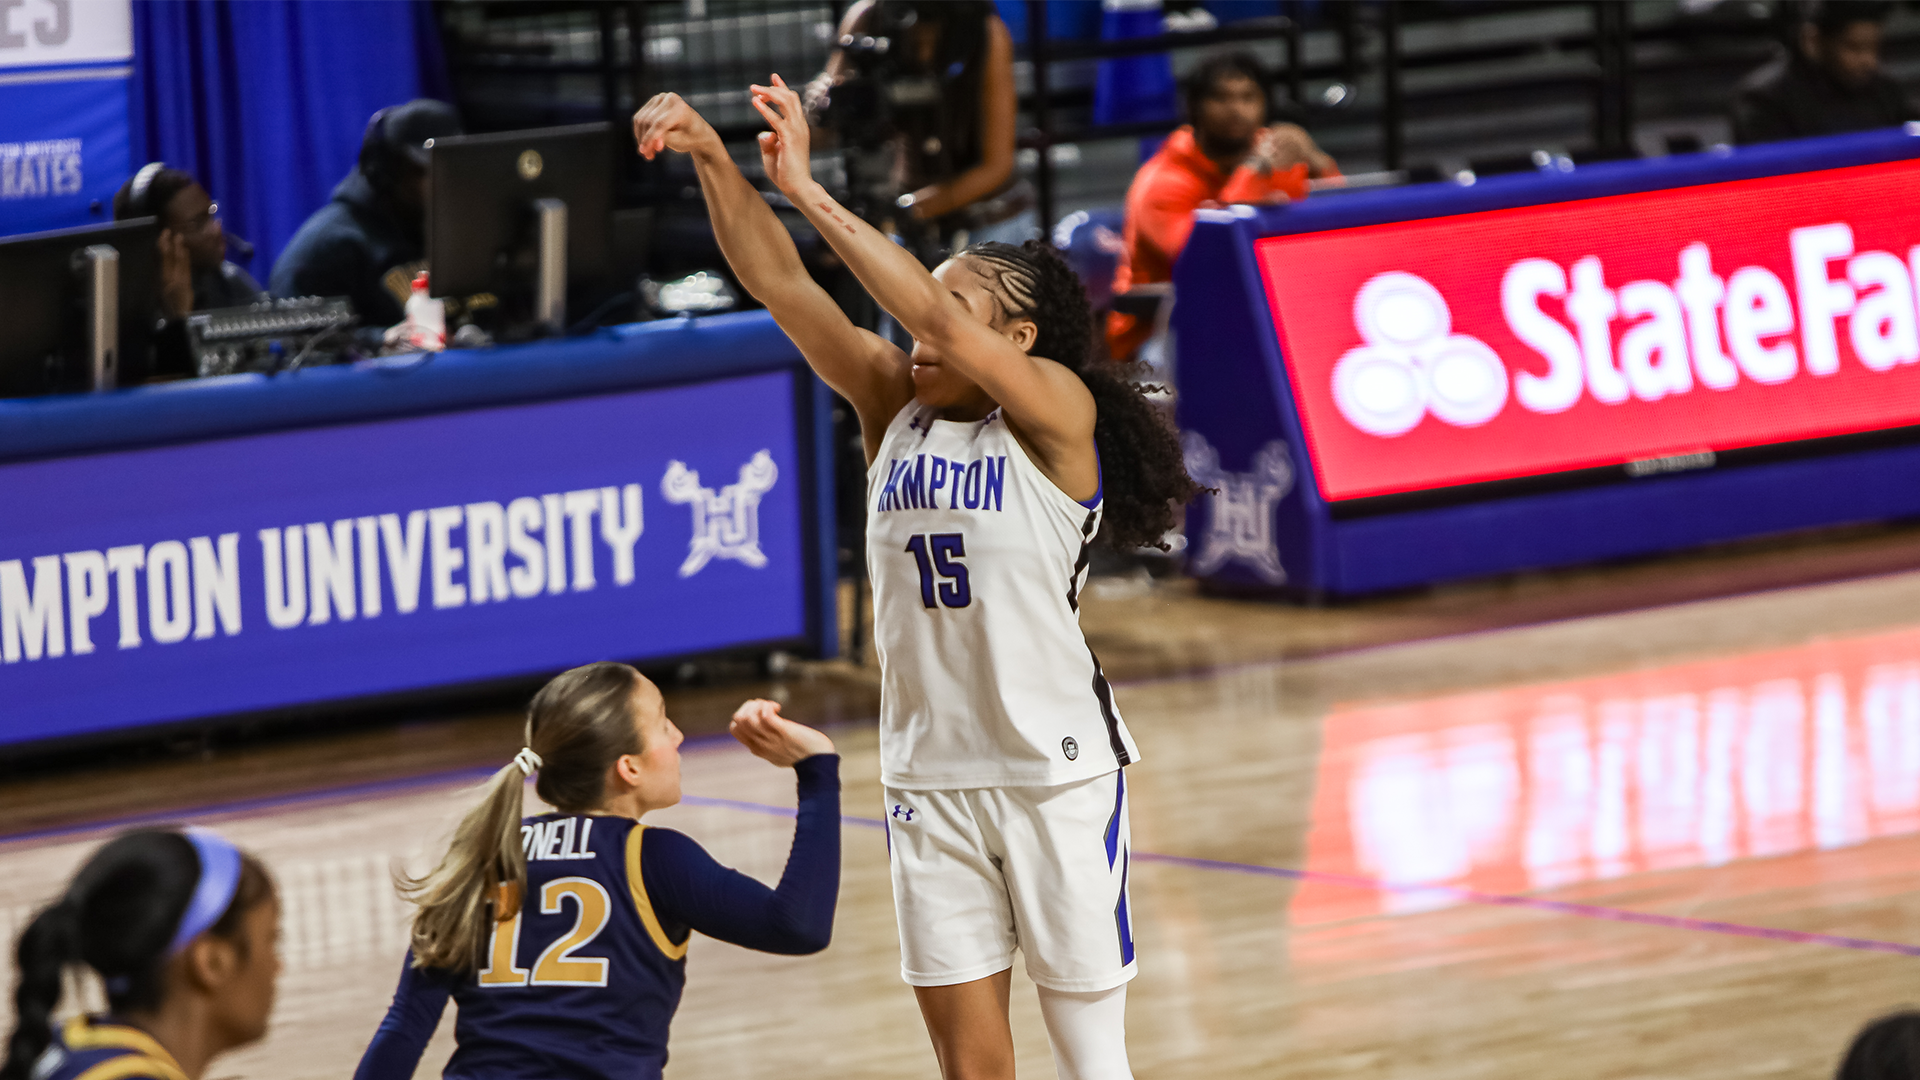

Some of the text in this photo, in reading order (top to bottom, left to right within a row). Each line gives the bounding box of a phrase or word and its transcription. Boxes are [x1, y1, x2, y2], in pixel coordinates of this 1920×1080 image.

[1502, 222, 1920, 414] StateFa
[0, 483, 644, 665] MPTON UNIVERSITY
[904, 532, 973, 609] 15
[478, 876, 612, 988] 12
